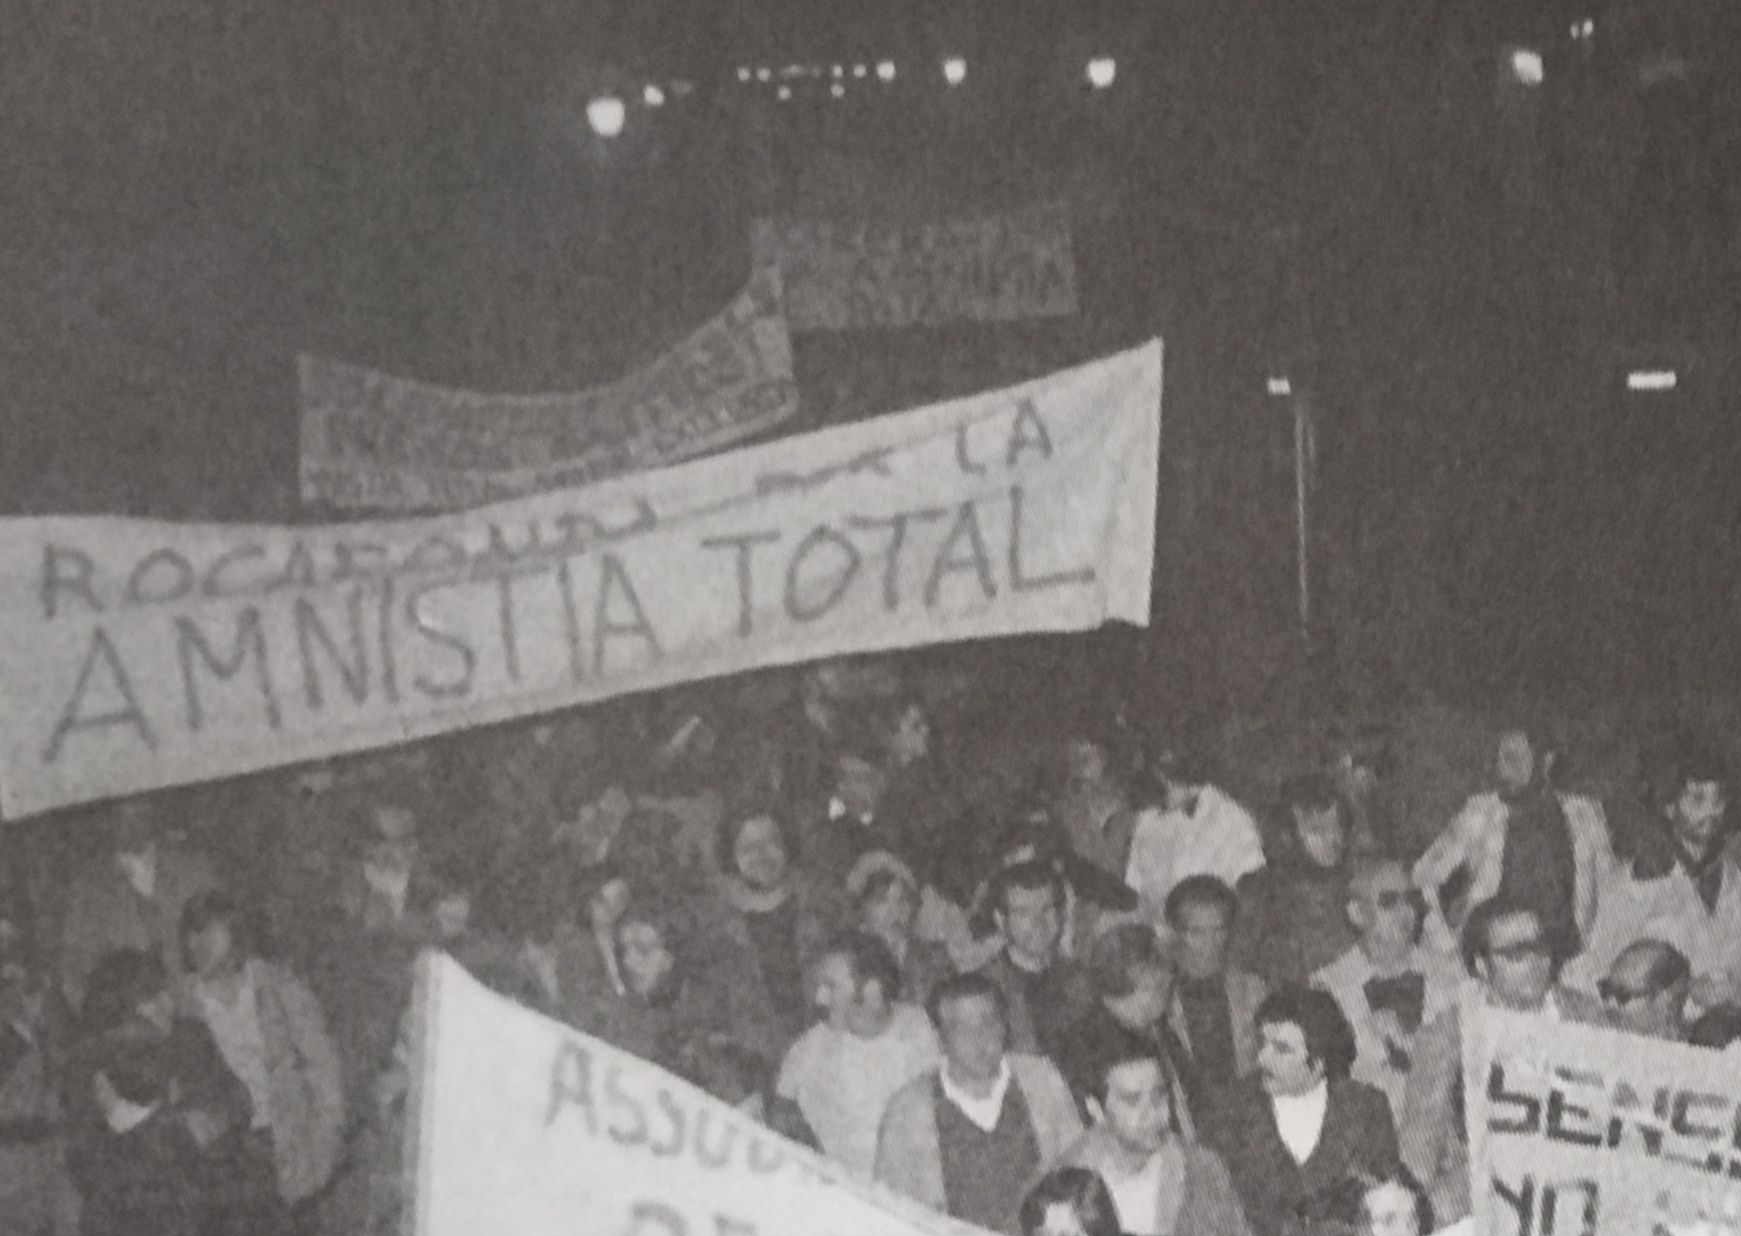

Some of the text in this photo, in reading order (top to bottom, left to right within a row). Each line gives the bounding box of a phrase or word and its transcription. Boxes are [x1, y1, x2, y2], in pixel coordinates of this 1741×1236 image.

[954, 398, 1055, 476] LA
[42, 486, 1096, 763] AMNISTIA TOTAL
